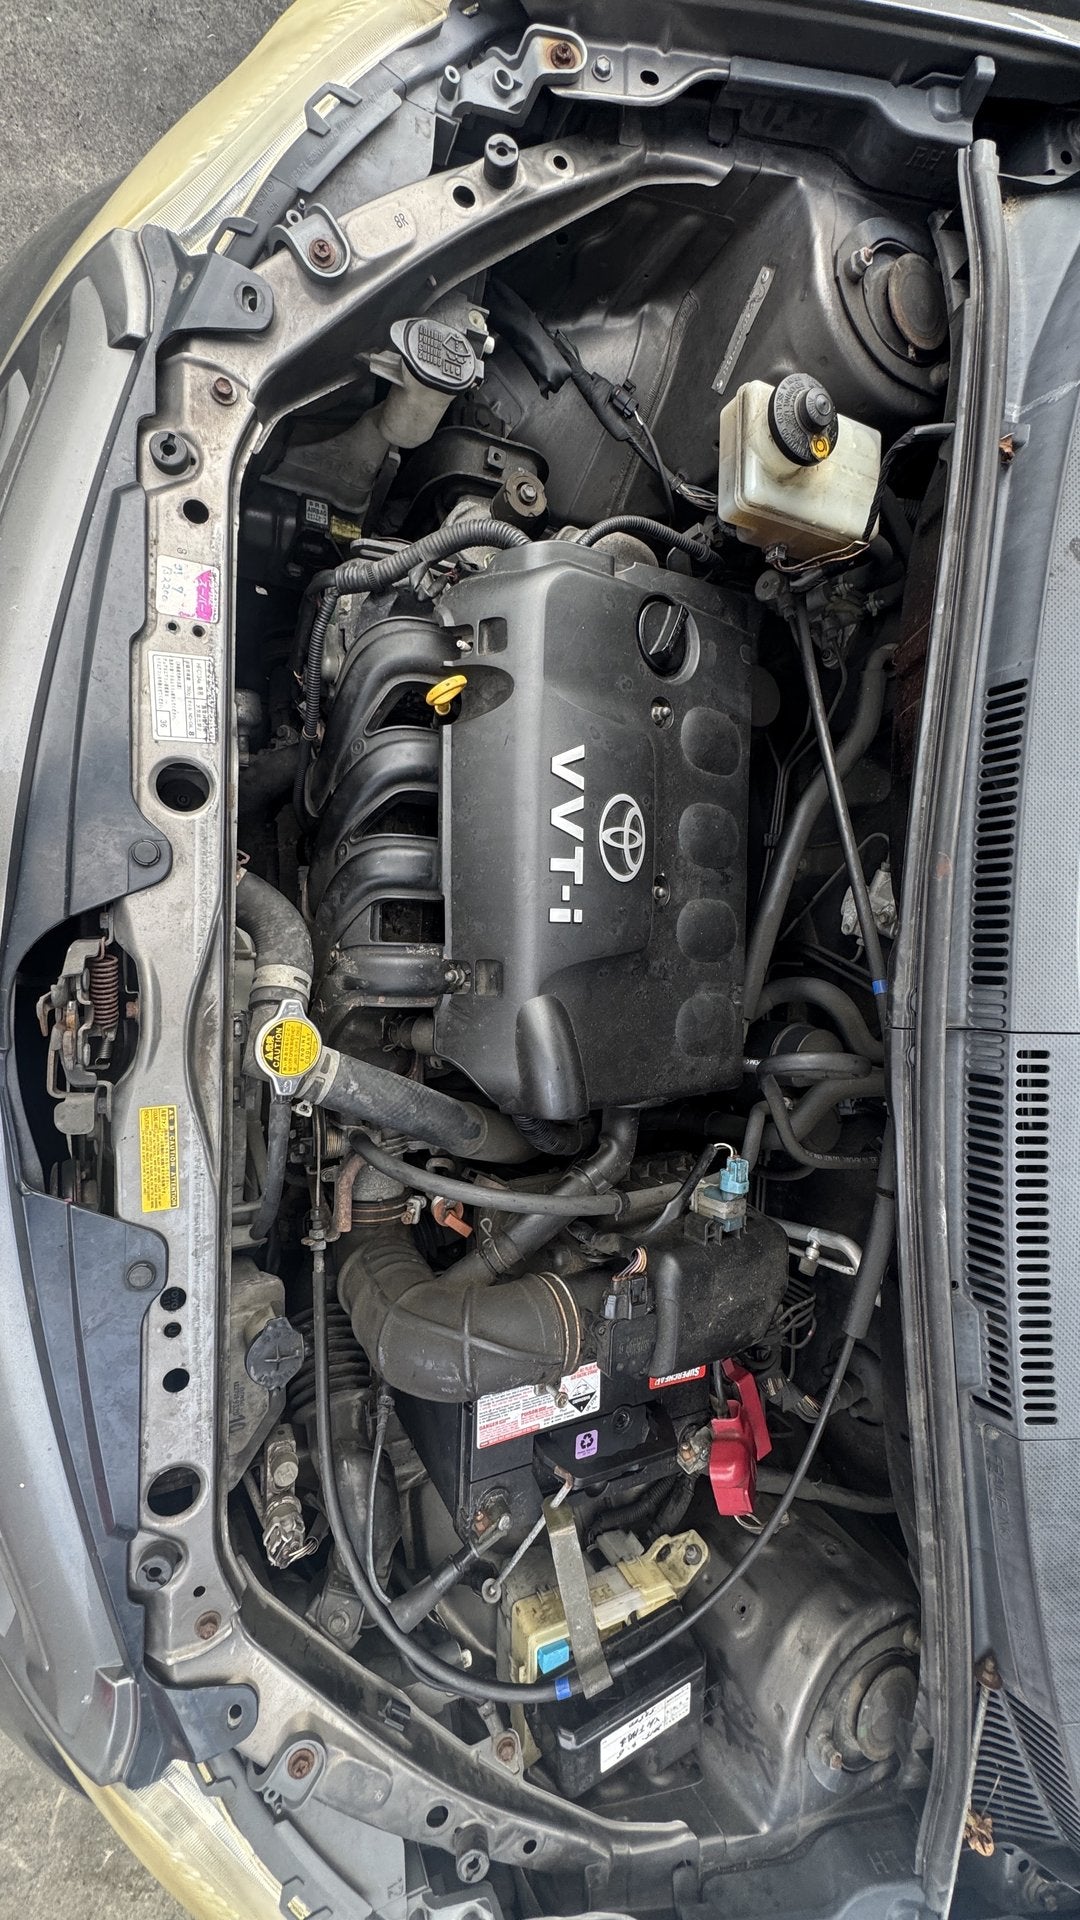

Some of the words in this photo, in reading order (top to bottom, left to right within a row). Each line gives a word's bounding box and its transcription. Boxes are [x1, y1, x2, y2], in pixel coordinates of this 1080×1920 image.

[394, 212, 410, 230] 8R
[160, 719, 168, 728] 36
[549, 744, 586, 923] VVT-i
[273, 1027, 282, 1068] CAUTION
[654, 1366, 701, 1386] SUPERCHEAP
